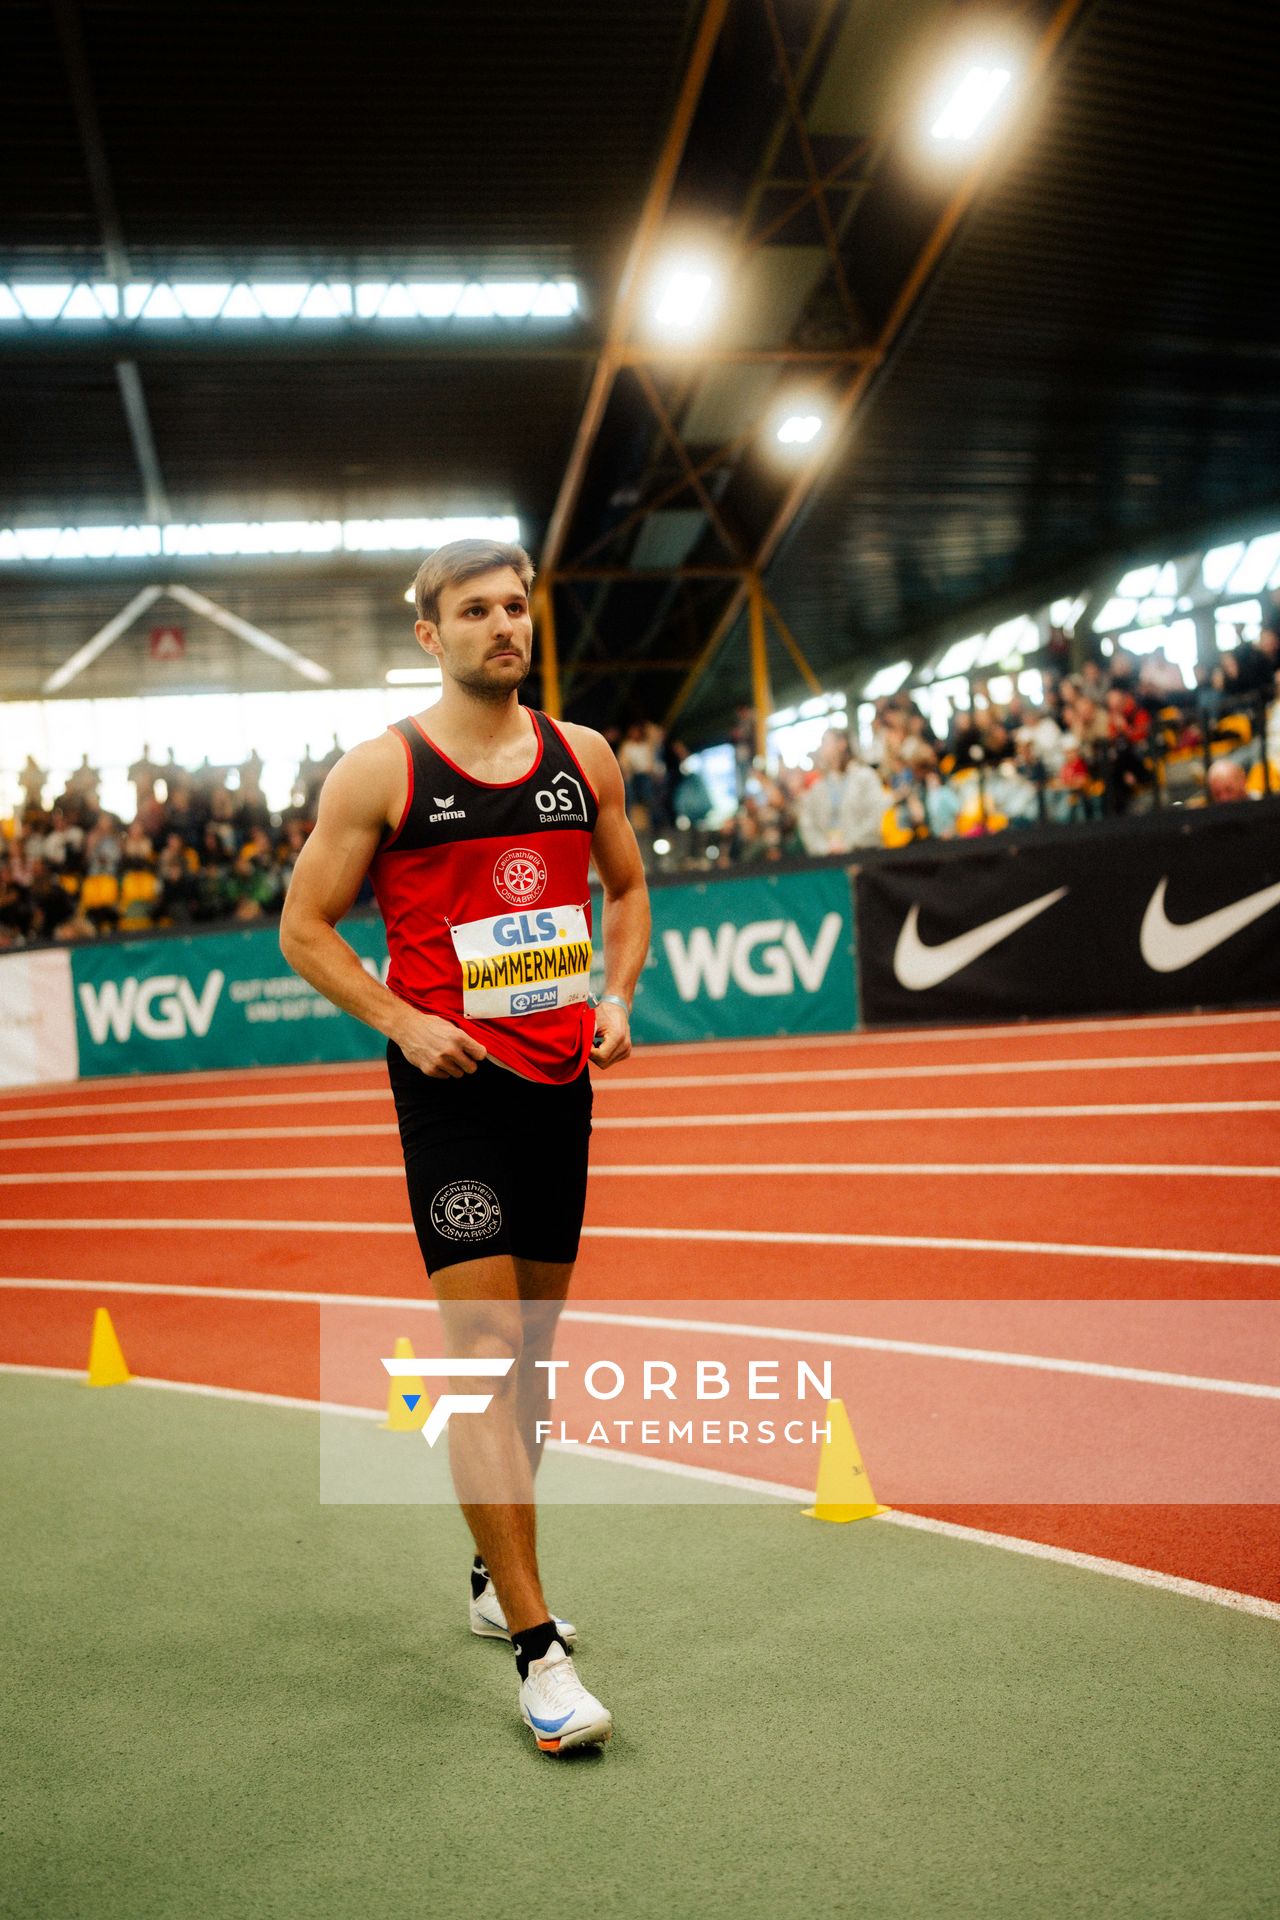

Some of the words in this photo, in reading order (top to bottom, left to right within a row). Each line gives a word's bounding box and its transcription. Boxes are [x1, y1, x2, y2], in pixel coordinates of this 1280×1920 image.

[535, 788, 573, 813] OS
[429, 809, 466, 823] erima
[539, 812, 584, 824] BauImmo
[498, 851, 541, 871] Leichtathletik
[466, 943, 589, 989] DAMMERMANN
[664, 911, 843, 1001] WGV
[78, 969, 225, 1044] WGV
[531, 991, 557, 1004] PLAN
